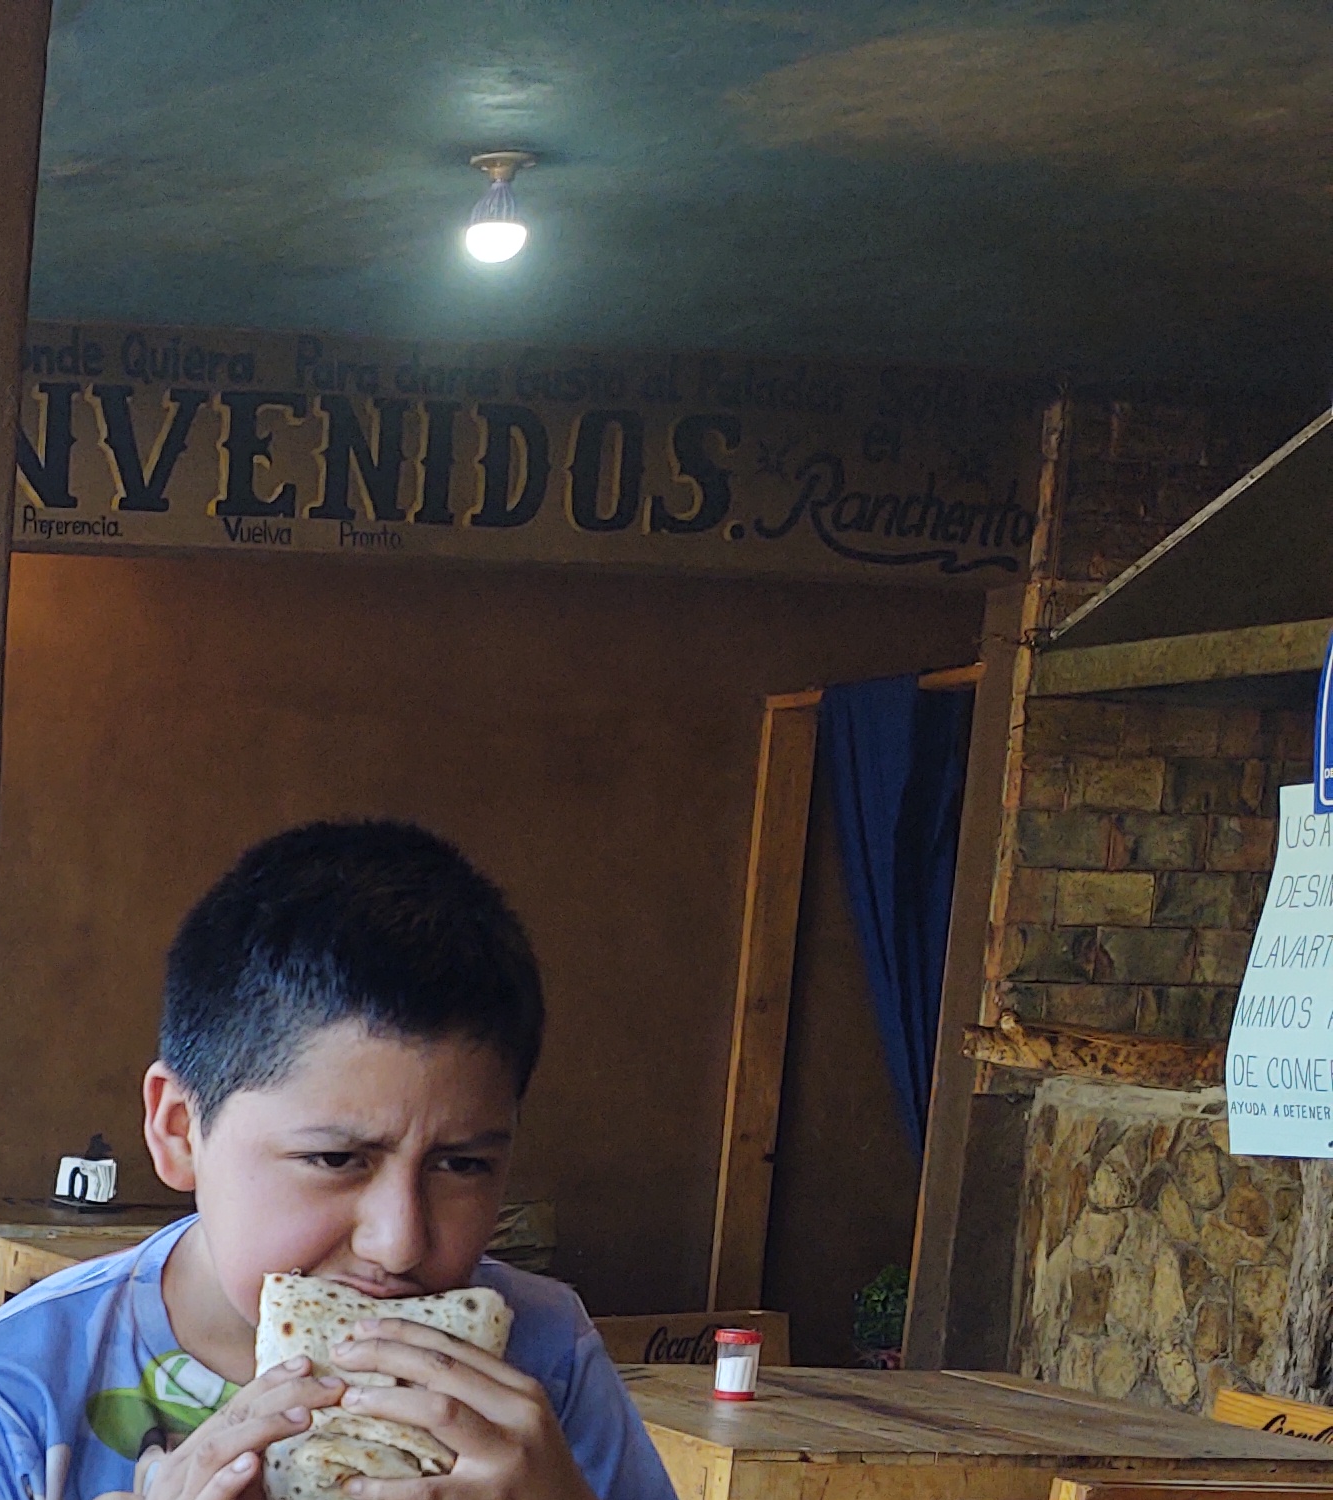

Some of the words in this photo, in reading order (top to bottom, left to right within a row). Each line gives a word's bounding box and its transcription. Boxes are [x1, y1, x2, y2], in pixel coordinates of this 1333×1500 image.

[223, 516, 292, 545] Vuelva
[340, 520, 402, 549] Pronto
[1235, 995, 1313, 1029] MANOS
[1233, 1054, 1259, 1088] DE
[1230, 1101, 1267, 1117] AYUDA
[1273, 1104, 1280, 1118] A
[1283, 1104, 1331, 1121] DETENER
